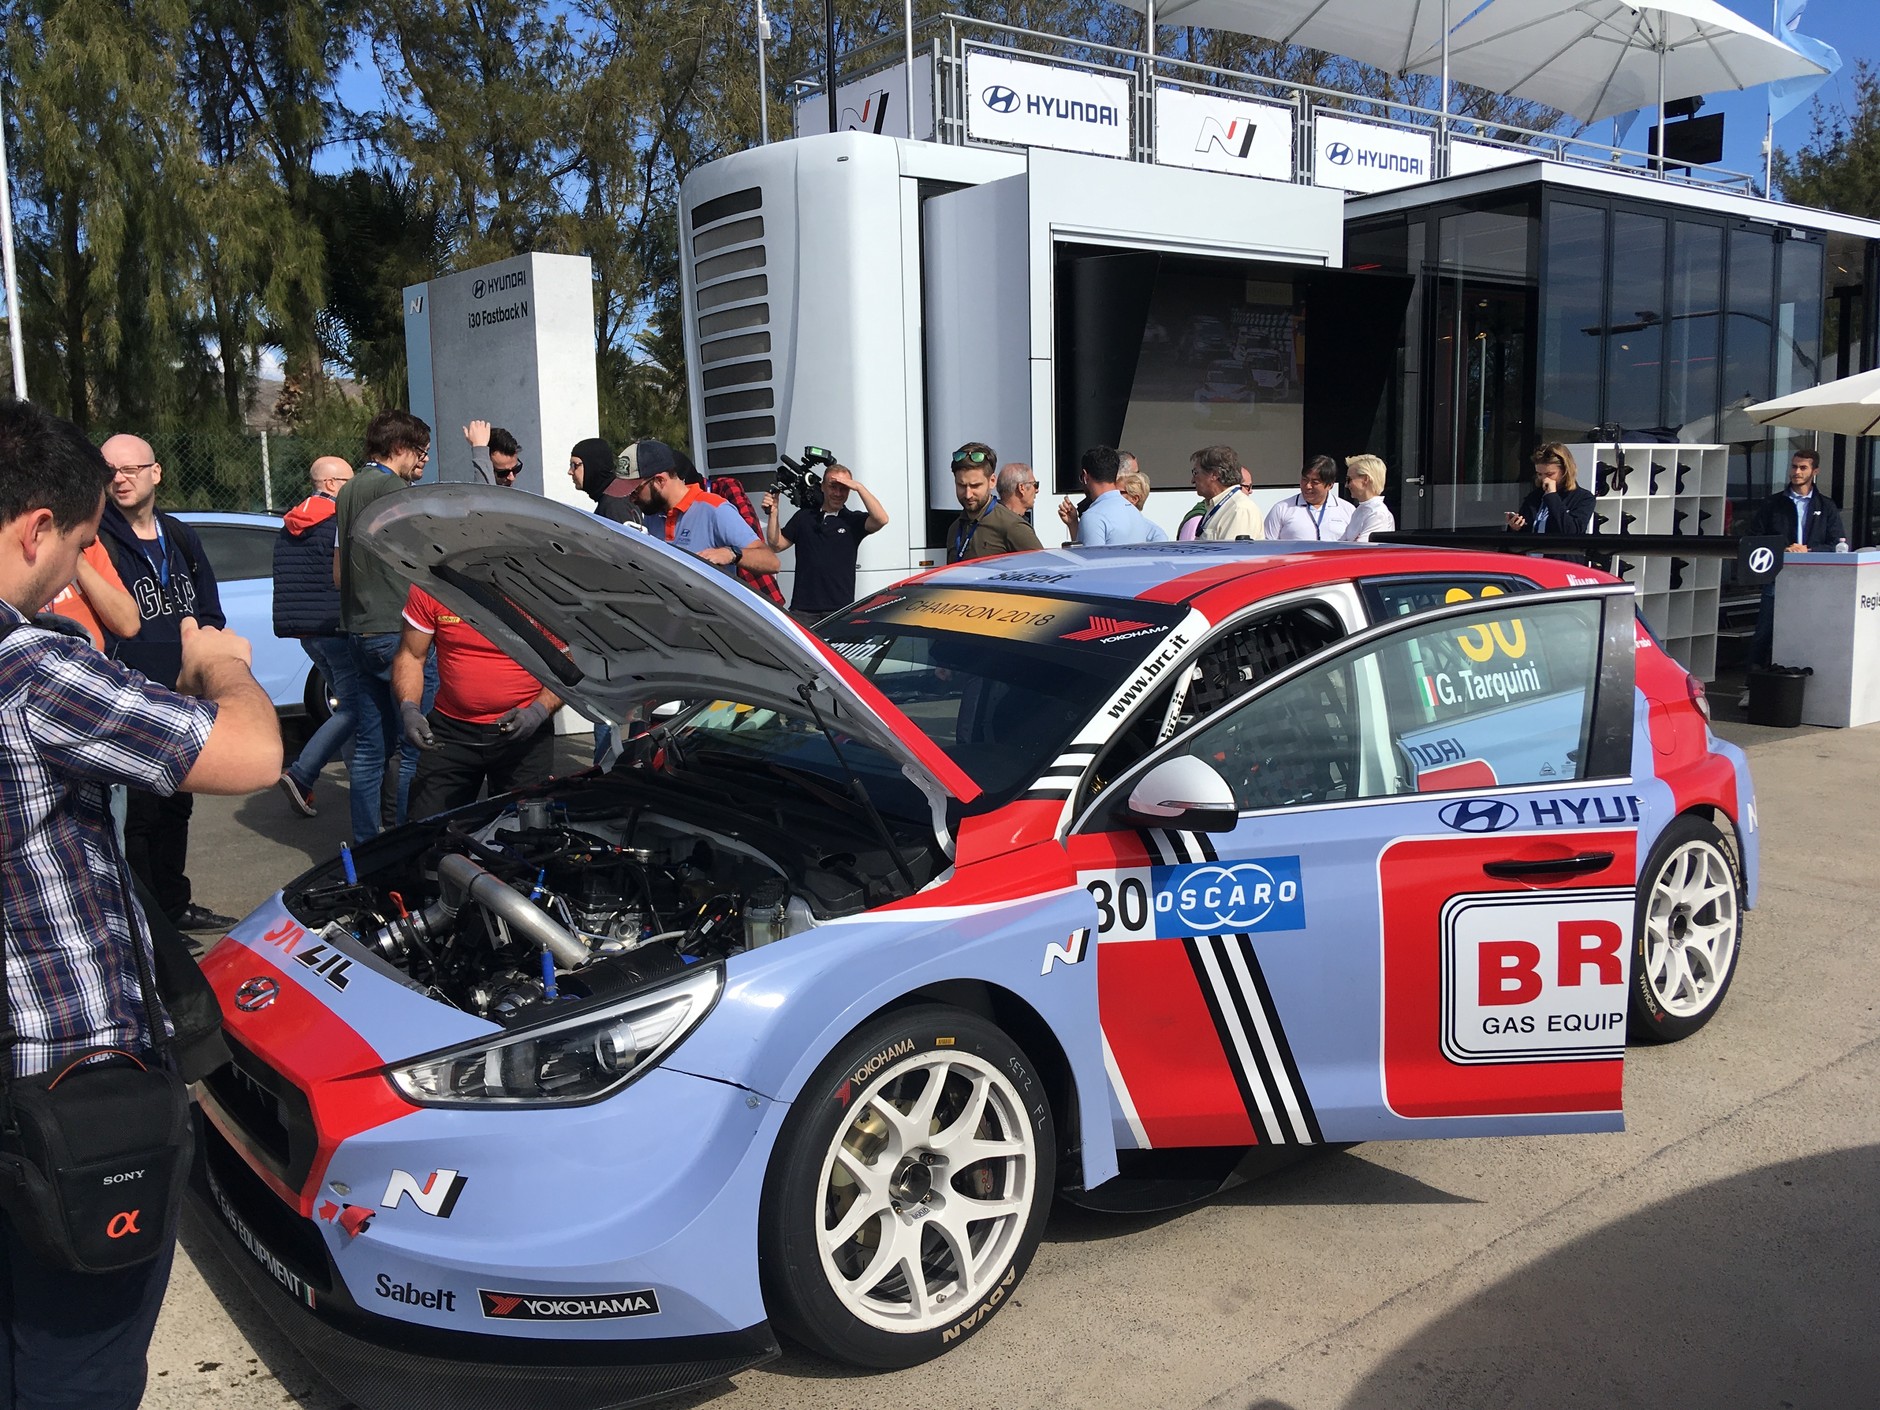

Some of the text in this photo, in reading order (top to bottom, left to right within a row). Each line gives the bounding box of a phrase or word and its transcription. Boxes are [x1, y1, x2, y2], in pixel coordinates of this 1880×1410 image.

[1026, 92, 1118, 127] HYUNDAI
[1357, 148, 1423, 176] HYUNDAI
[487, 269, 526, 294] HYUNDAI
[468, 301, 528, 329] i30 Fastback N
[905, 600, 1056, 627] CHAMPION 2018
[1100, 625, 1169, 645] YOKOHAMA
[1107, 633, 1190, 719] www.brc.it
[1436, 660, 1541, 705] G. Tarquini
[1718, 838, 1741, 890] ADVAN
[1086, 877, 1149, 933] 30
[1155, 879, 1297, 913] OSCARO
[1482, 1014, 1536, 1036] GAS
[850, 1038, 916, 1087] YOKOHAMA
[1007, 1057, 1026, 1079] SET
[103, 1169, 145, 1186] SONY
[237, 1219, 300, 1297] EQUIPMENT
[374, 1272, 457, 1313] Sabelt
[523, 1295, 651, 1317] YOKOHAMA
[941, 1264, 1016, 1344] ADVAN
